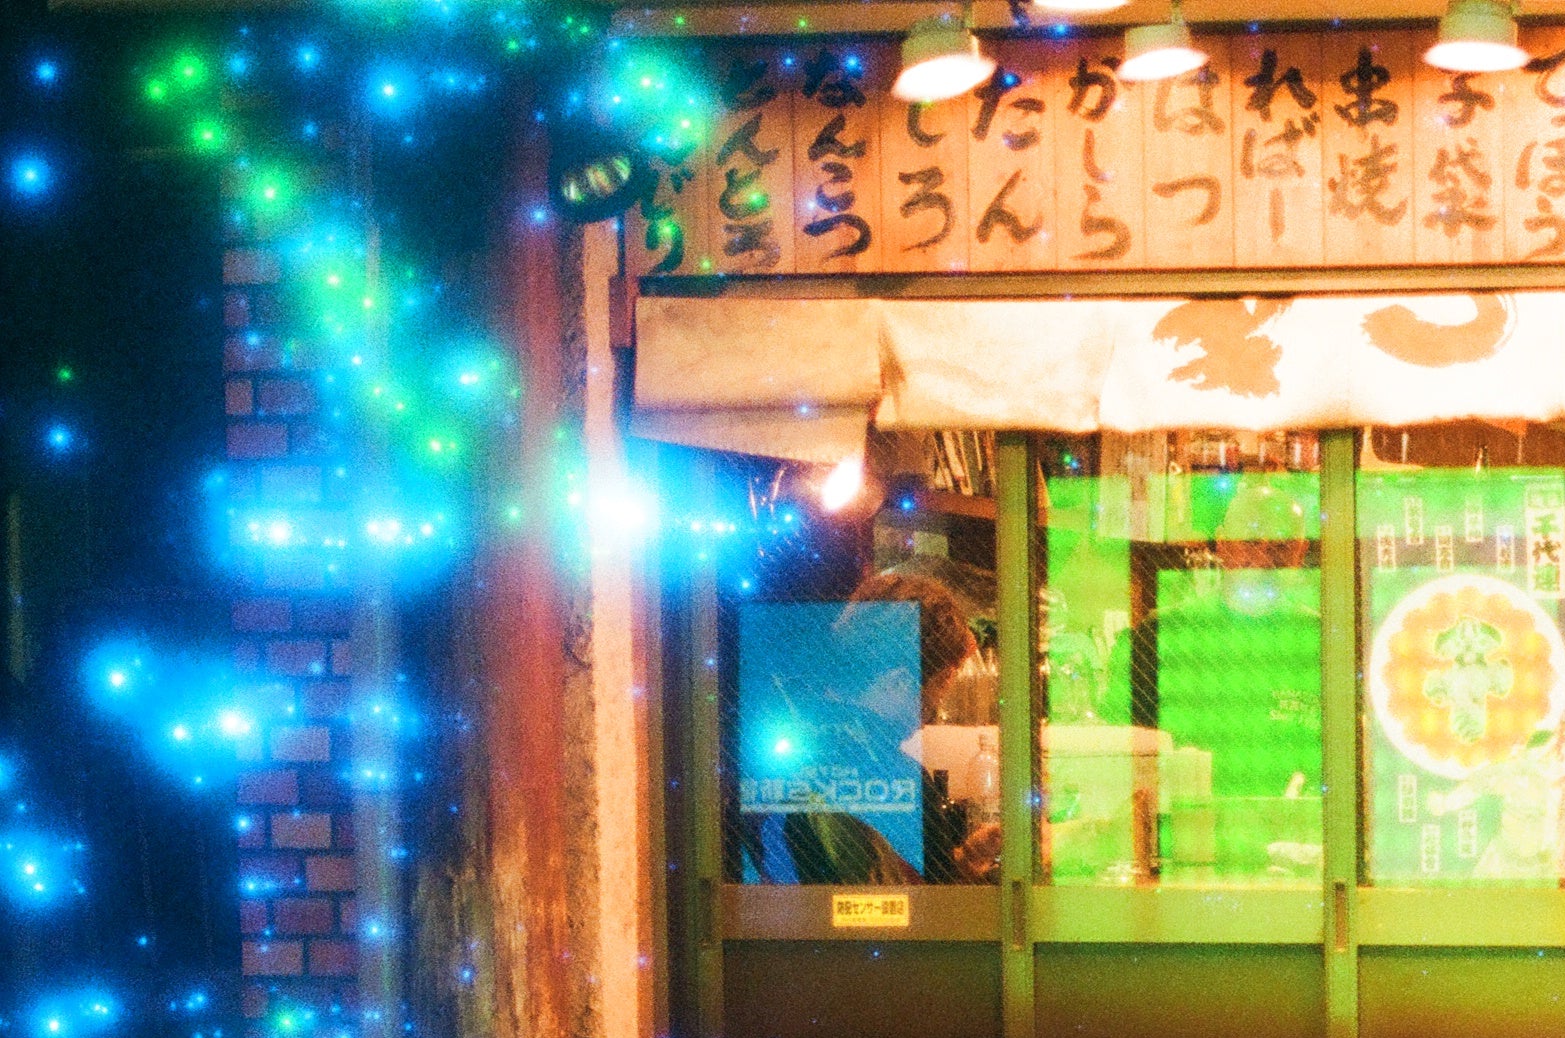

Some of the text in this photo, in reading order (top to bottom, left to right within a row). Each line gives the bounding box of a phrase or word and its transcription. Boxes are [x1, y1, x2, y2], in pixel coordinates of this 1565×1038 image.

[803, 48, 872, 261] なんこつ
[970, 65, 1045, 244] たん
[1067, 56, 1132, 261] かしら
[1152, 64, 1226, 226] はつ
[1240, 49, 1320, 243] ればー
